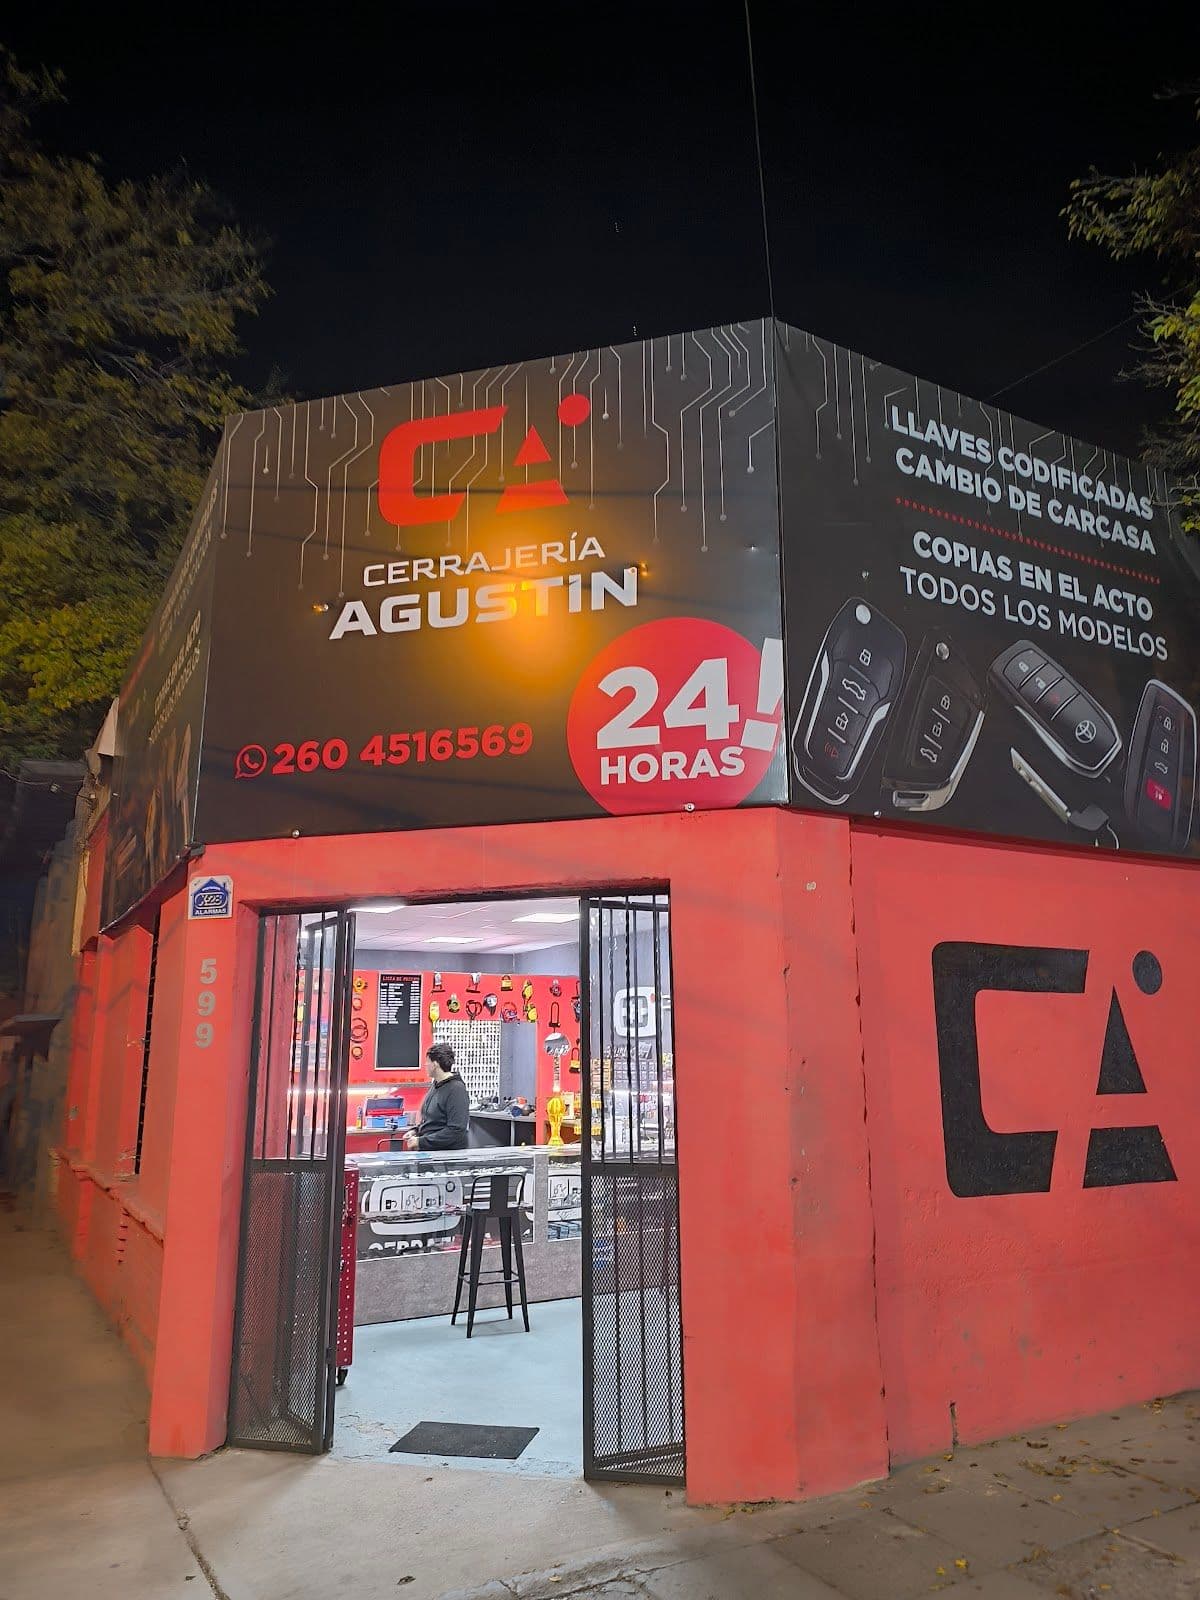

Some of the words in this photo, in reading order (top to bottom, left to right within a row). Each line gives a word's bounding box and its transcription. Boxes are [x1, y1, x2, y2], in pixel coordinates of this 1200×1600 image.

[892, 405, 992, 463] LLAVES
[998, 446, 1154, 520] CODIFICADAS
[896, 447, 1001, 504] CAMBIO
[1008, 484, 1042, 518] DE
[1047, 499, 1156, 555] CARCASA
[363, 532, 606, 587] CERRAJERÍA
[913, 531, 1013, 582] COPIAS
[1019, 561, 1053, 594] EN
[1058, 572, 1088, 604] EL
[1093, 584, 1153, 621] ACTO
[329, 566, 638, 640] AGUSTIN
[900, 566, 996, 616] TODOS
[1003, 594, 1051, 630] LOS
[1059, 610, 1168, 661] MODELOS
[272, 738, 349, 775] 260
[359, 722, 533, 766] 4516569
[600, 746, 746, 785] HORAS
